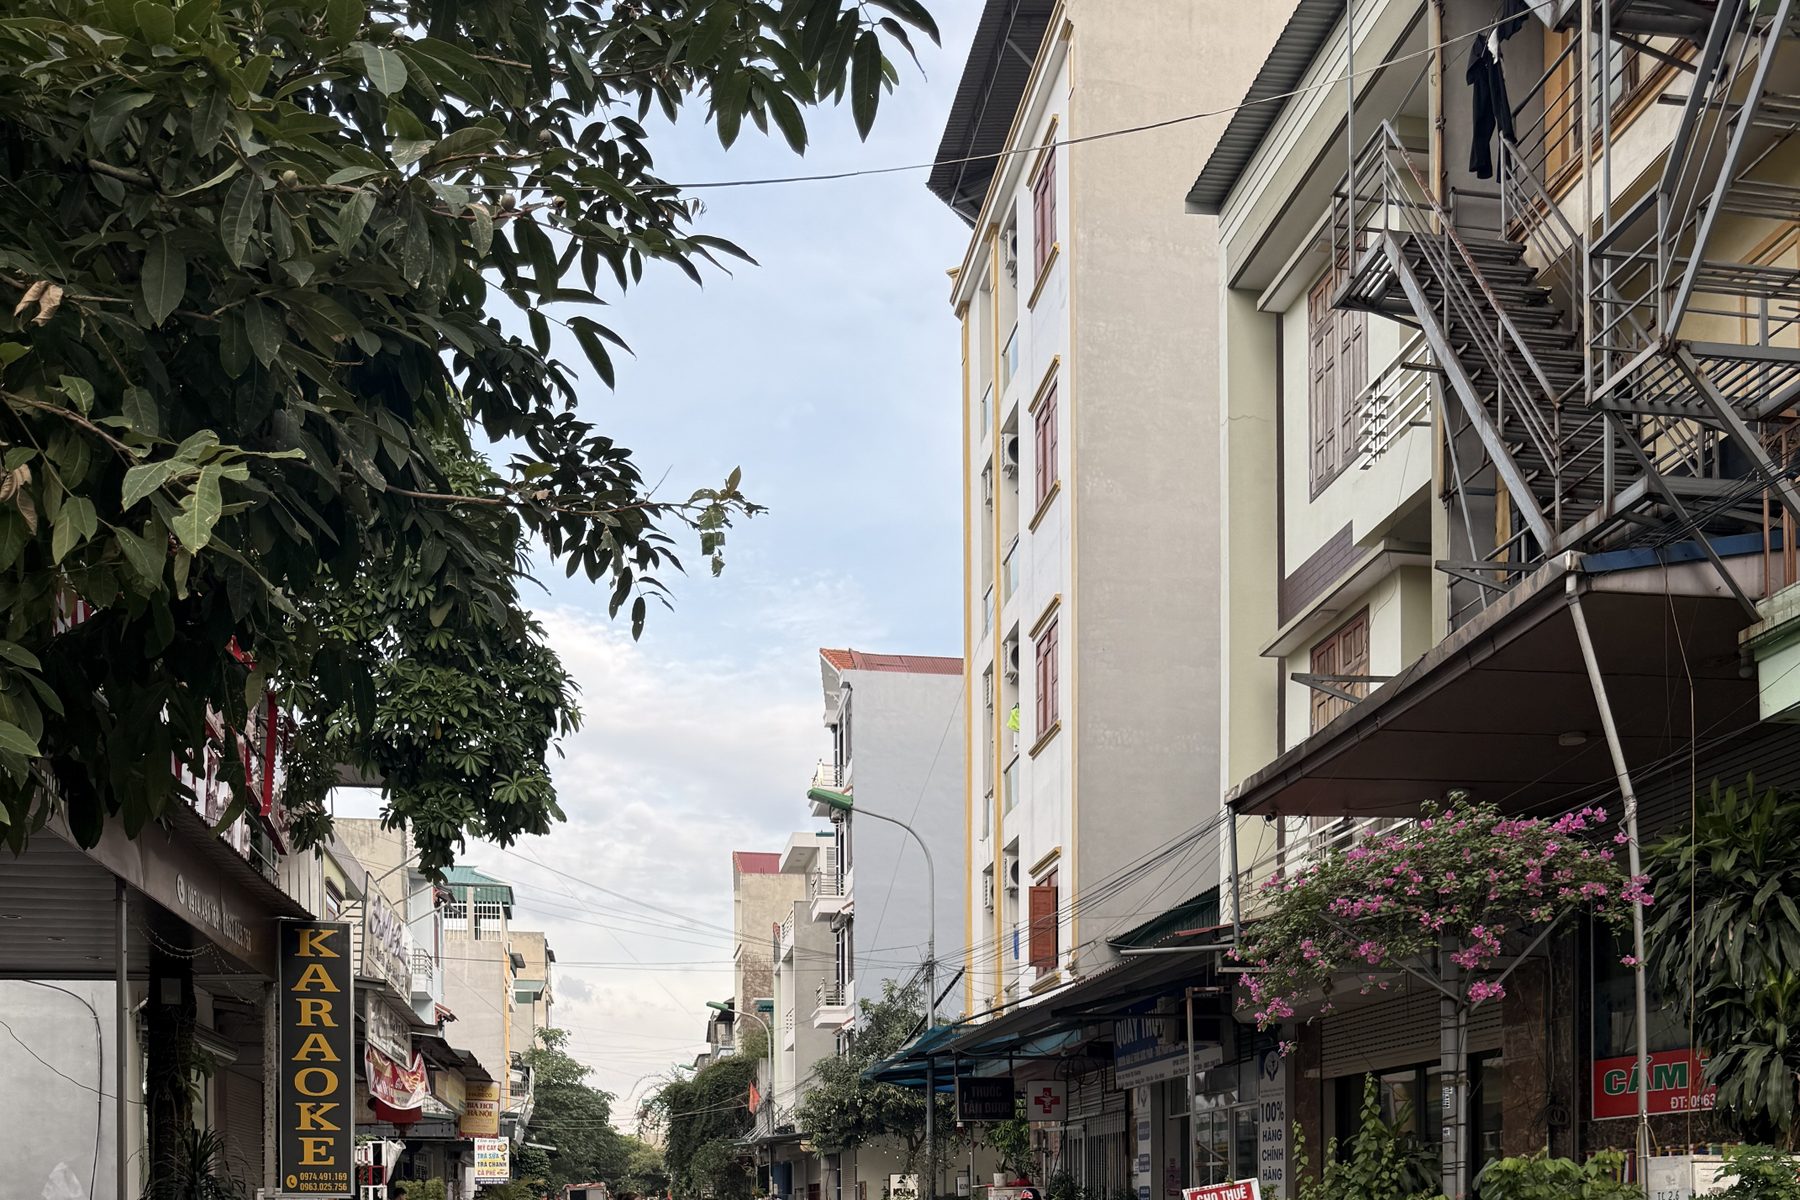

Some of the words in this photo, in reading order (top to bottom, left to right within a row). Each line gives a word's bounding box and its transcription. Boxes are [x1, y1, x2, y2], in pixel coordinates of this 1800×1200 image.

[291, 928, 341, 1166] KARAOKE
[1261, 1101, 1284, 1123] 100%
[1262, 1146, 1284, 1161] CHÍNH
[300, 1172, 348, 1181] 0974.491.169
[300, 1182, 348, 1191] 0963.025.756
[1657, 1192, 1665, 1200] TC
[1668, 1190, 1680, 1200] 2.6
